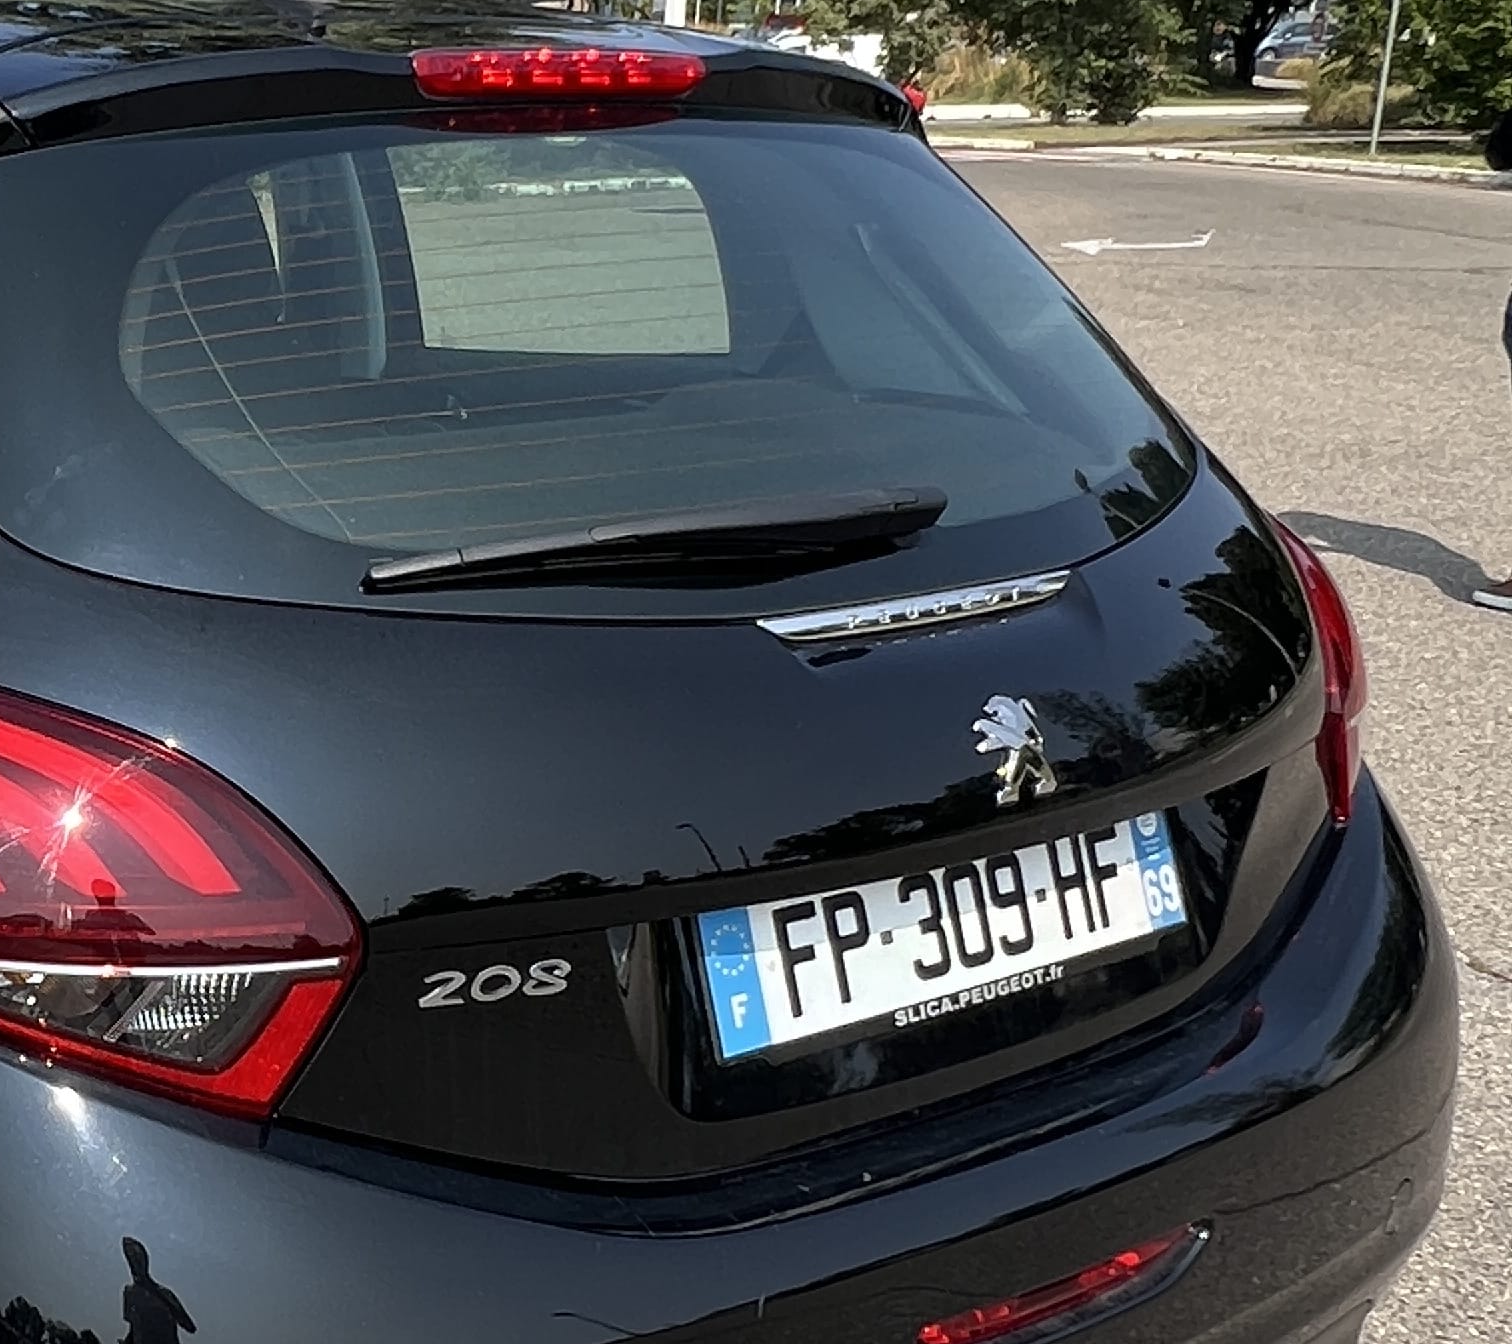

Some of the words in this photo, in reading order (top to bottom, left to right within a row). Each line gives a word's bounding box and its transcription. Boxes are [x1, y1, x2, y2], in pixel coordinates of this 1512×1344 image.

[1142, 864, 1180, 916] 69
[418, 958, 571, 1008] 208
[893, 964, 1065, 1027] SLICA.PEUGEOT.fr
[730, 992, 749, 1029] F
